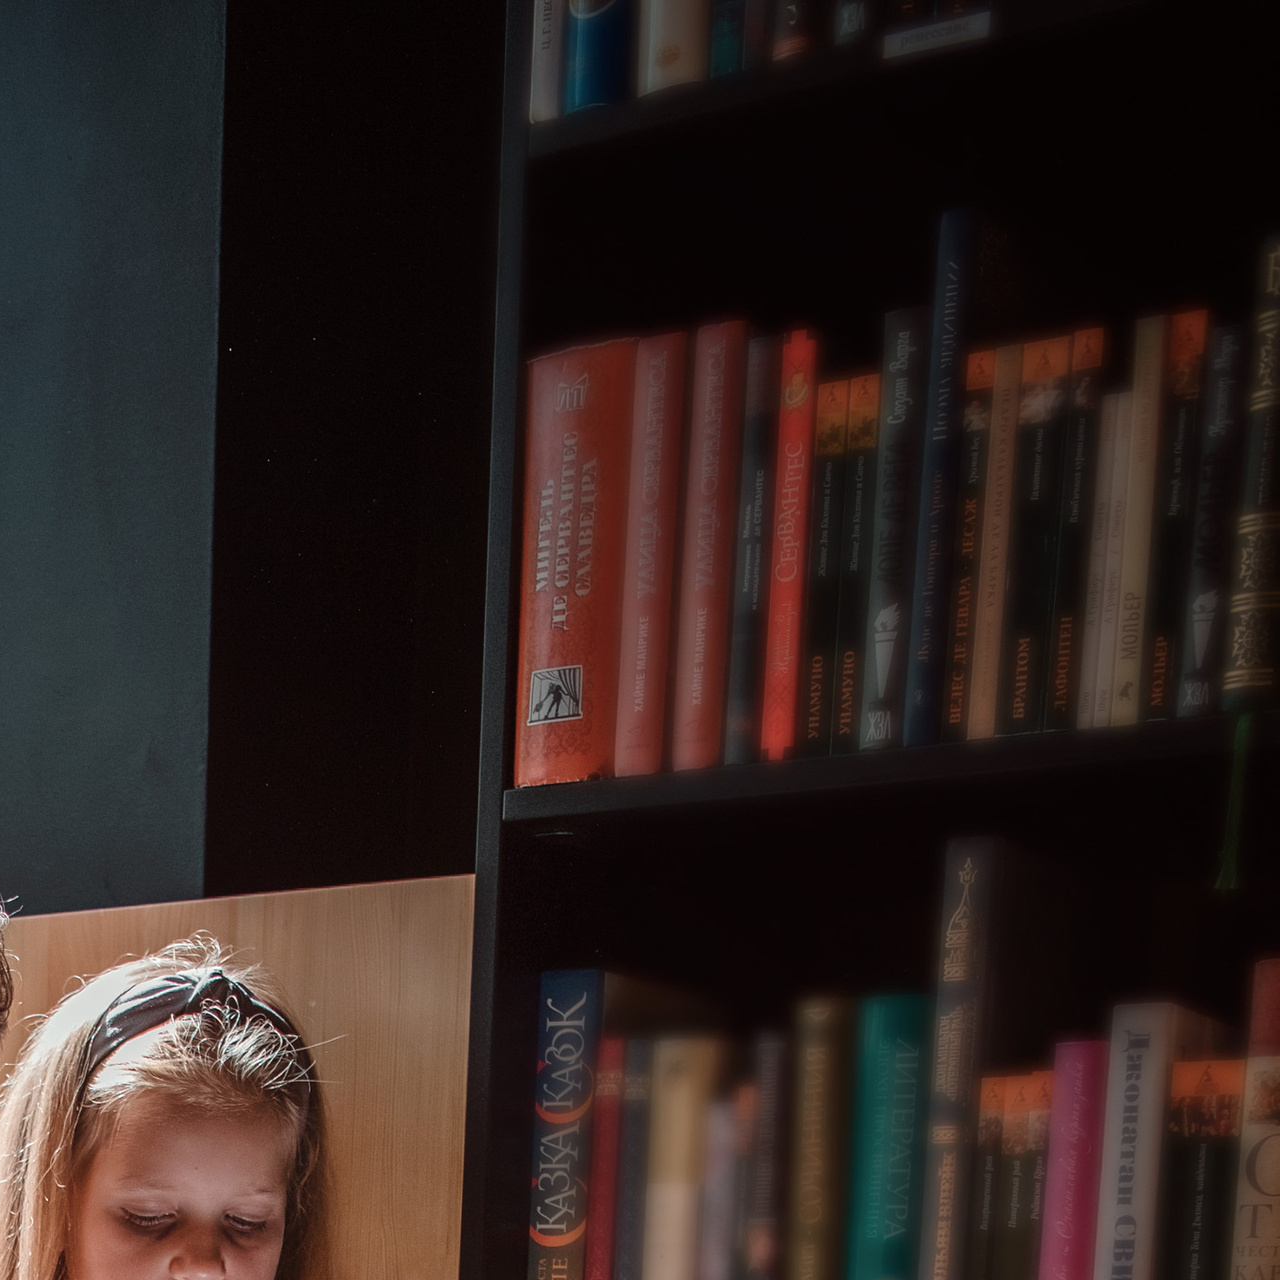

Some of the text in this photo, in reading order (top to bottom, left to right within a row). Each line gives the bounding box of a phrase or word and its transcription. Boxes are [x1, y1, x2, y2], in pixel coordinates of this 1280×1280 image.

[887, 330, 918, 425] Сюзанн Варга
[554, 430, 579, 589] СЕРВАНТЕС
[636, 350, 668, 600] УЛИЦА СЕРВАНТЕСА
[753, 469, 765, 524] СЕРВАНТЕС
[535, 479, 555, 593] МИГЕЛЬ
[551, 595, 571, 631] ДЕ
[691, 606, 708, 706] ХАЙМЕ МАНРИКЕ
[948, 497, 979, 724] ВЕЛЕС ДЕ ГЕВАРА ЛЕСАЖ
[1120, 591, 1142, 660] МОЛЬЕР
[634, 615, 650, 712] ХАЙМЕ МАНРИКЕ
[808, 655, 823, 739] УНАМУНО
[839, 650, 856, 736] УНАМУНО
[1012, 636, 1031, 720] БРАНТОМ
[1053, 615, 1073, 712] ЛАФОНТЕН
[1150, 635, 1168, 707] МОЛЬЕР
[883, 1037, 920, 1241] ЛИТЕРАТУРА
[1116, 1030, 1151, 1206] Джонатан
